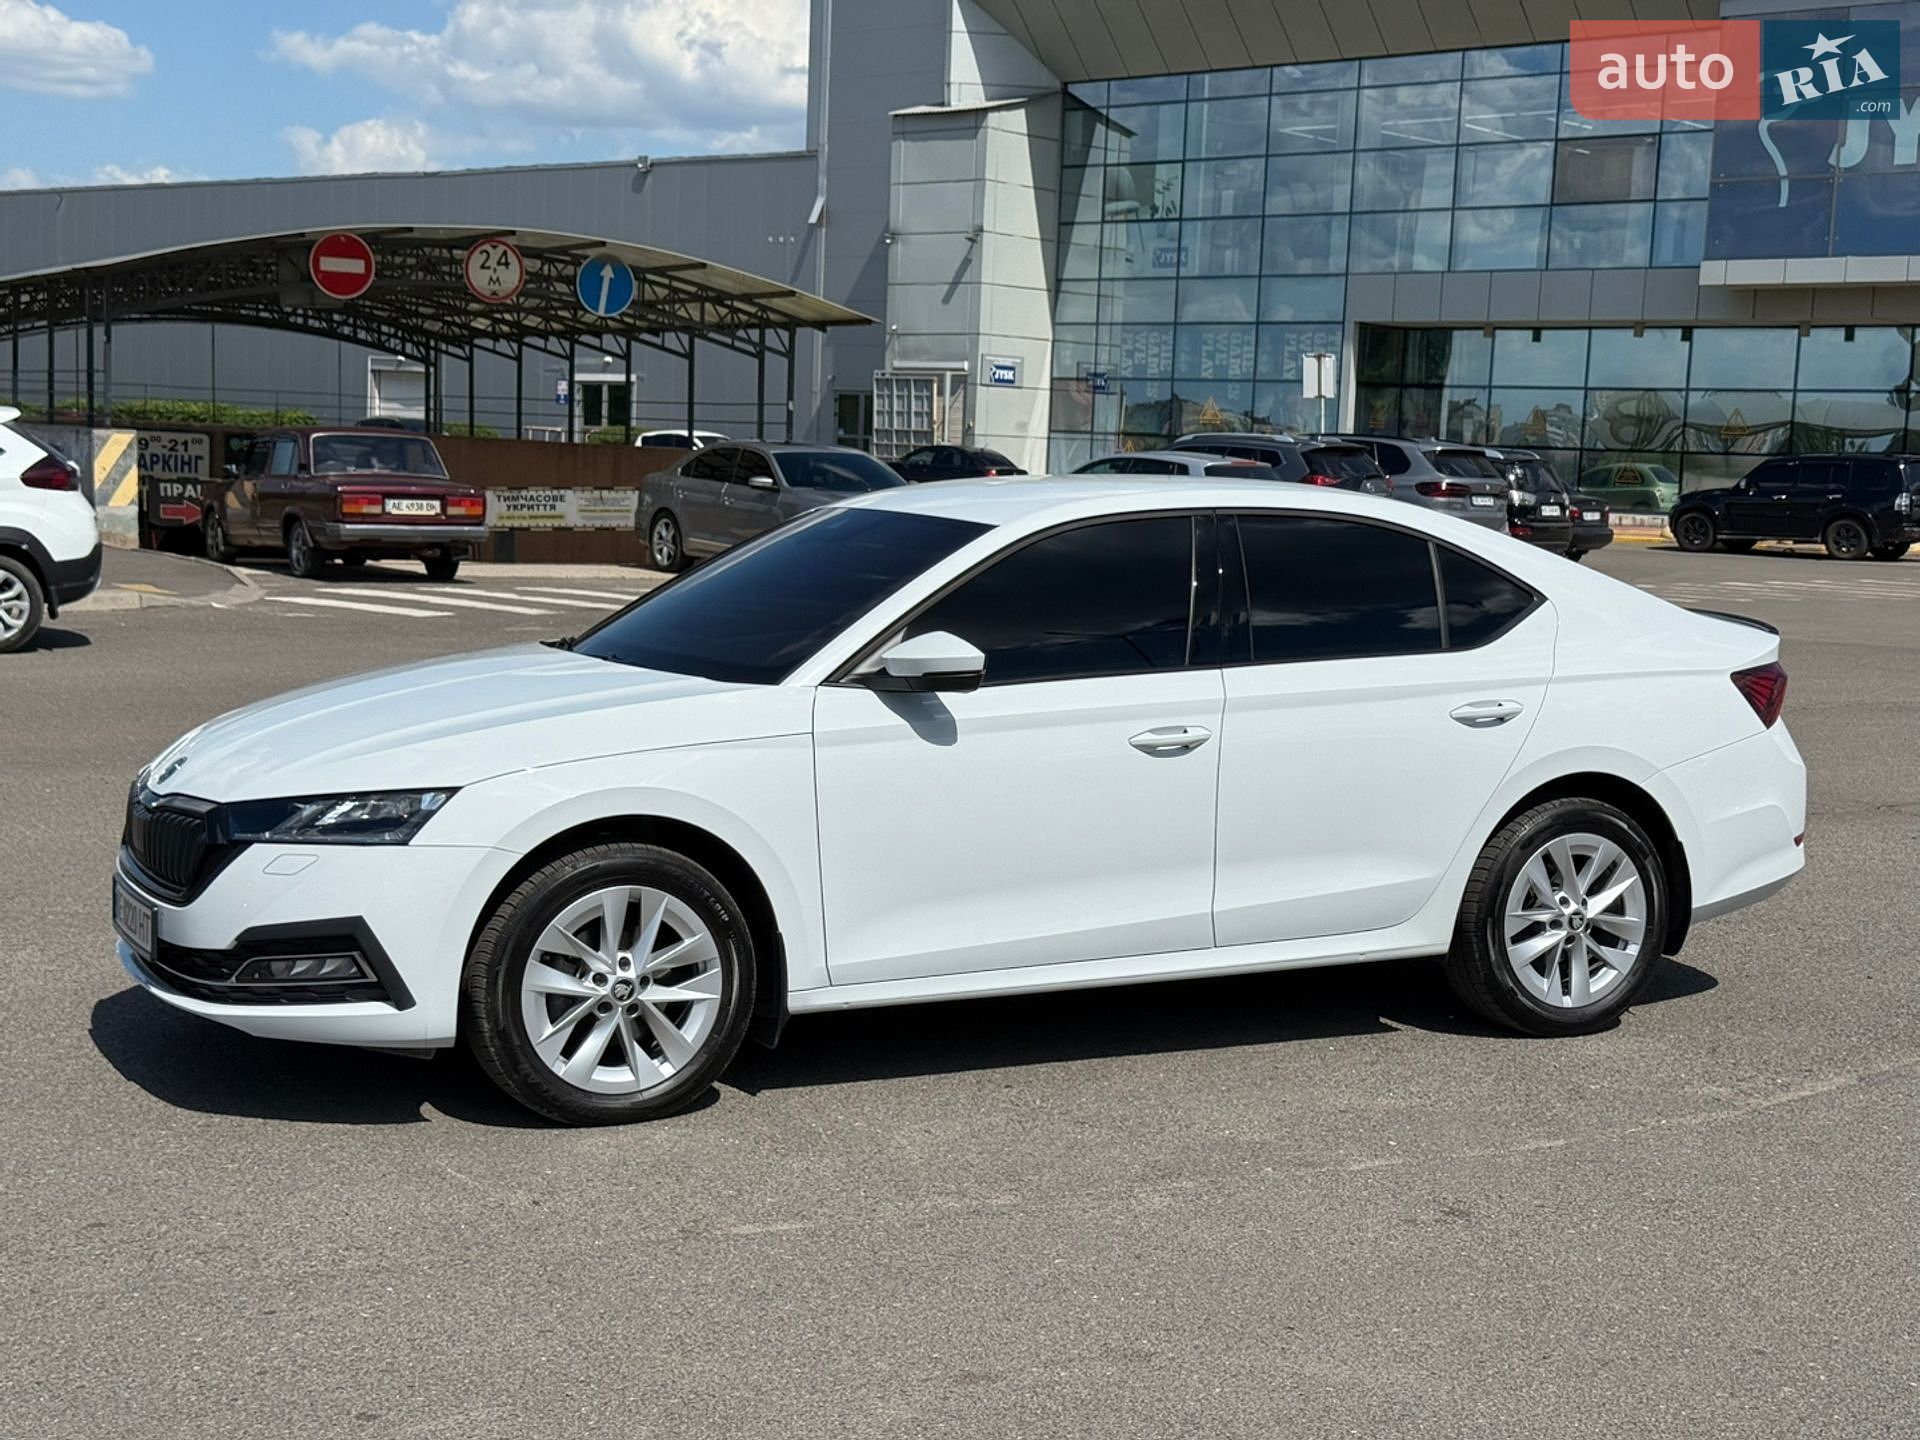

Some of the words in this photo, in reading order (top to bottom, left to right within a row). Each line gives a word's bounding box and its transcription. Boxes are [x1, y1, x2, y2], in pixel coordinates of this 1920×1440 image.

[994, 369, 1015, 381] JYSK
[139, 453, 204, 474] АРКІНГ
[496, 494, 566, 503] ТИМЧАСОВЕ
[506, 503, 556, 512] УКРИТТЯ
